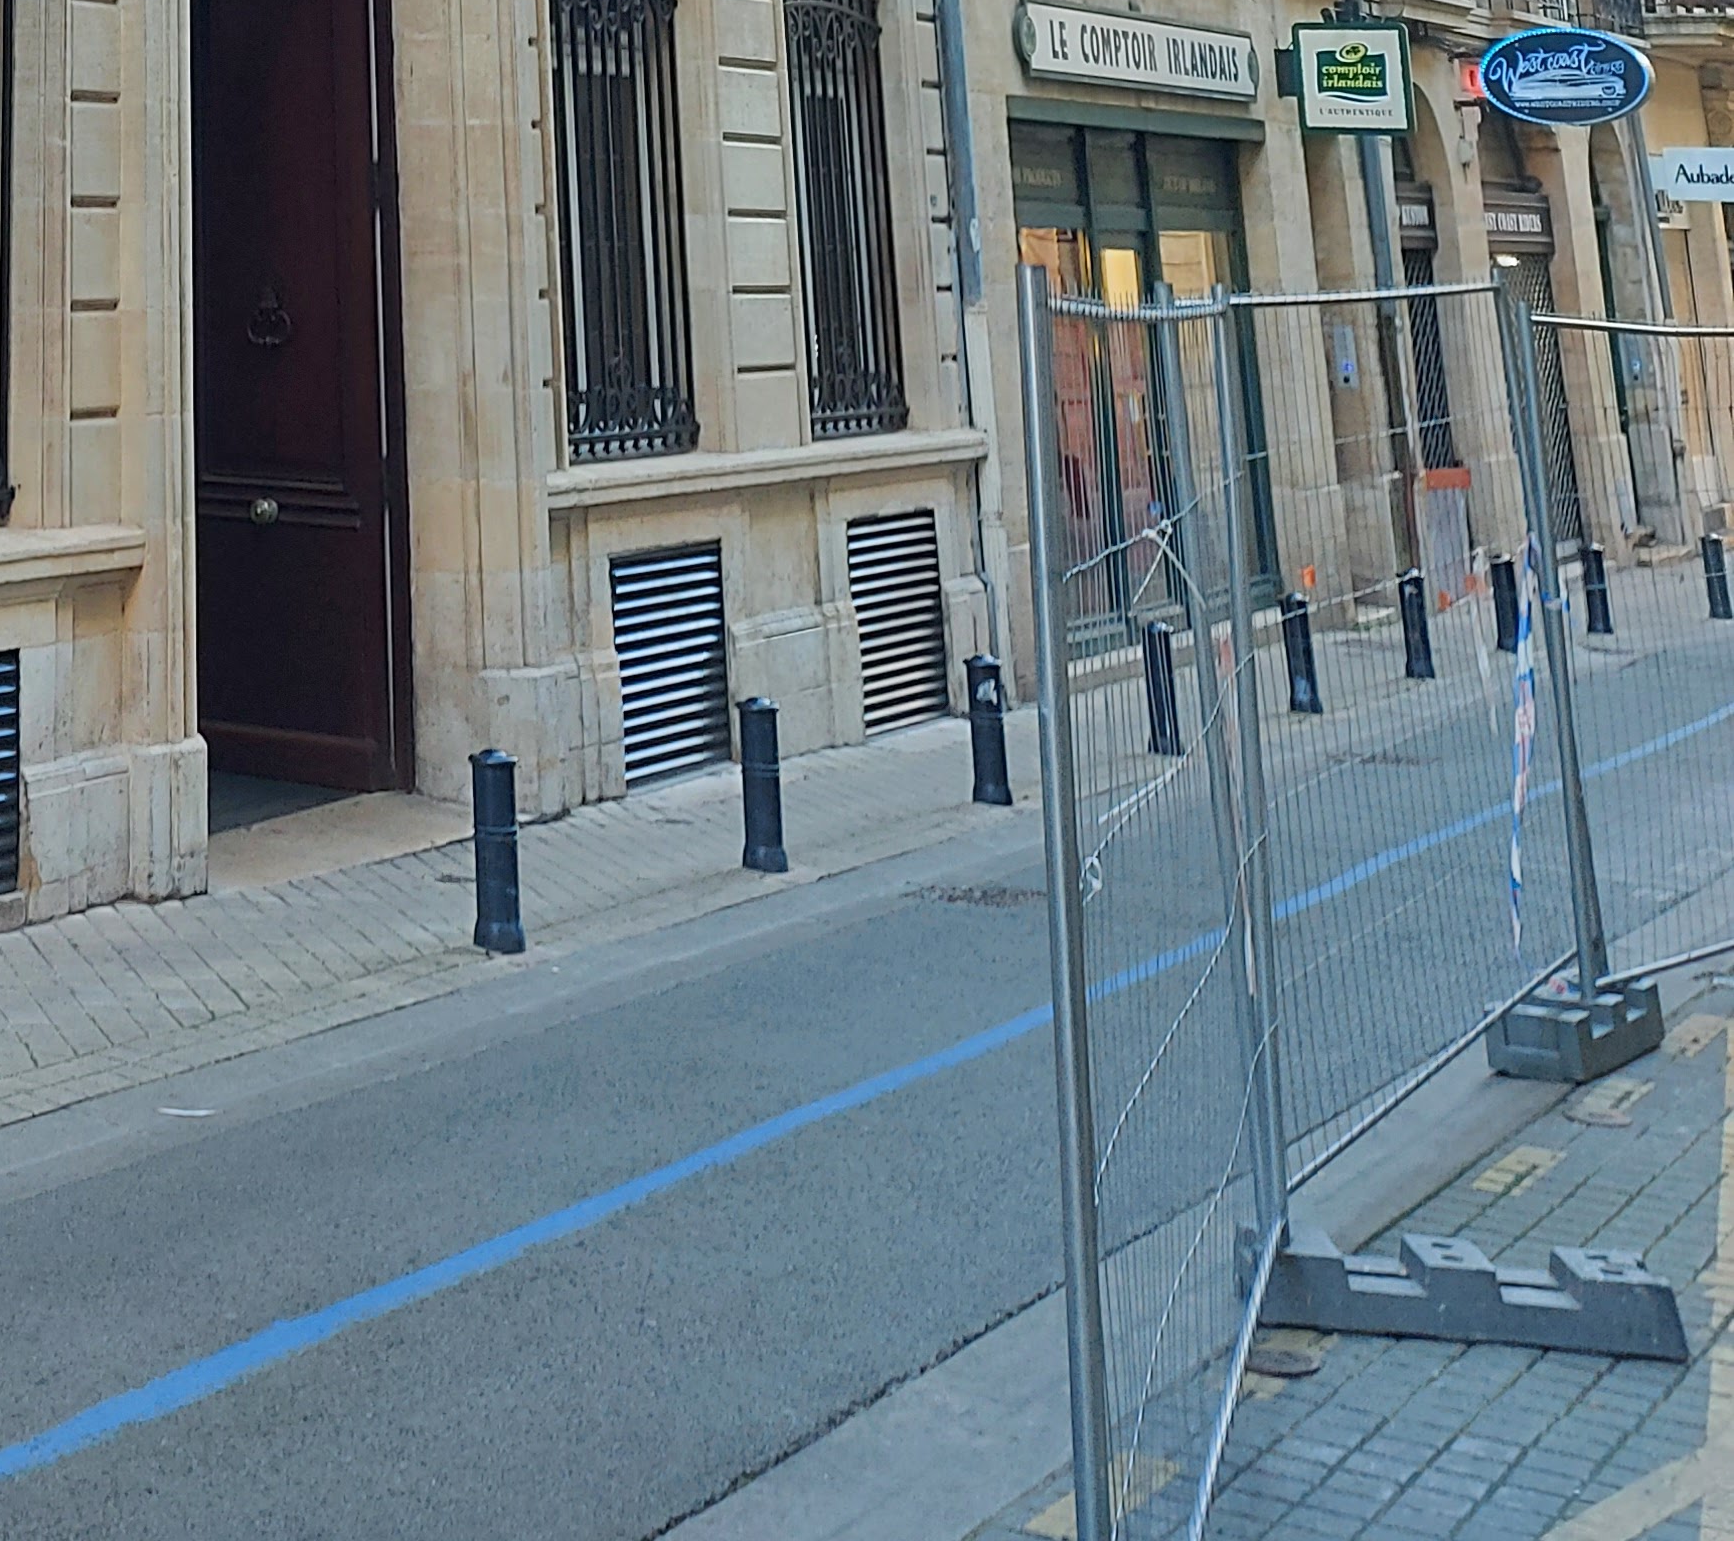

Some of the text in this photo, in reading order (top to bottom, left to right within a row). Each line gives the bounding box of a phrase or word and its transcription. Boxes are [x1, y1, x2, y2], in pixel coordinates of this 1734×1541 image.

[1049, 20, 1240, 83] LE COMPTOIR IRLANDAIS
[1322, 63, 1382, 78] comptoir
[1323, 75, 1383, 88] irlandais
